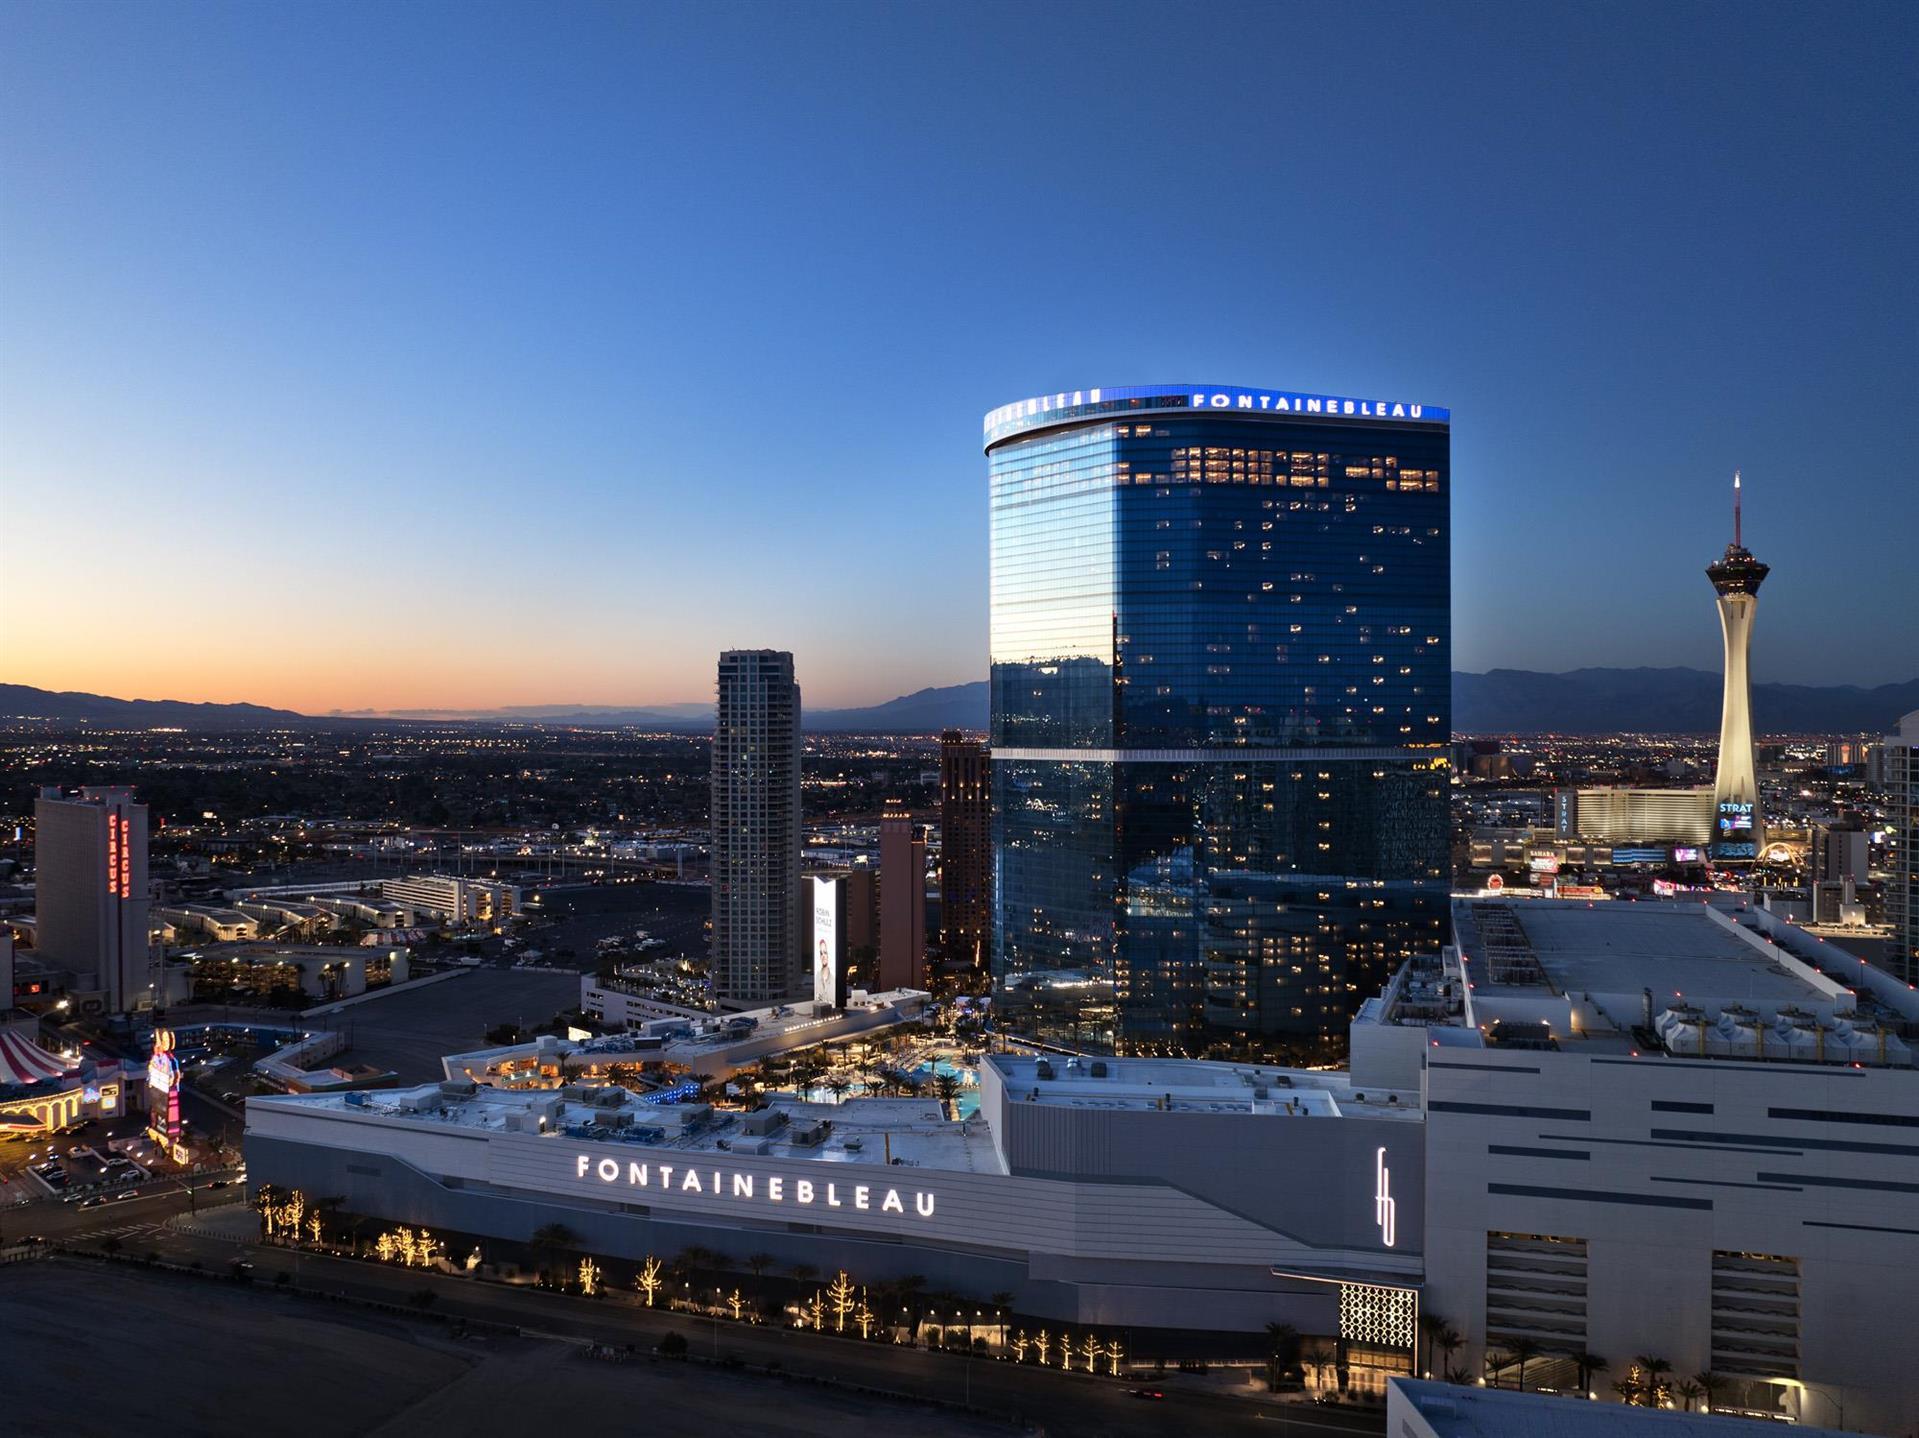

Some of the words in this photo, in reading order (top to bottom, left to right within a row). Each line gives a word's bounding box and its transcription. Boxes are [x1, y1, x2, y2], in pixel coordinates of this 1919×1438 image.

[1193, 394, 1422, 418] FONTAINEBLEAU
[1720, 803, 1753, 813] STRAT
[108, 814, 117, 893] CIRCUS
[121, 820, 130, 898] CIRCUS
[577, 1155, 935, 1217] FONTAINEBLEAU
